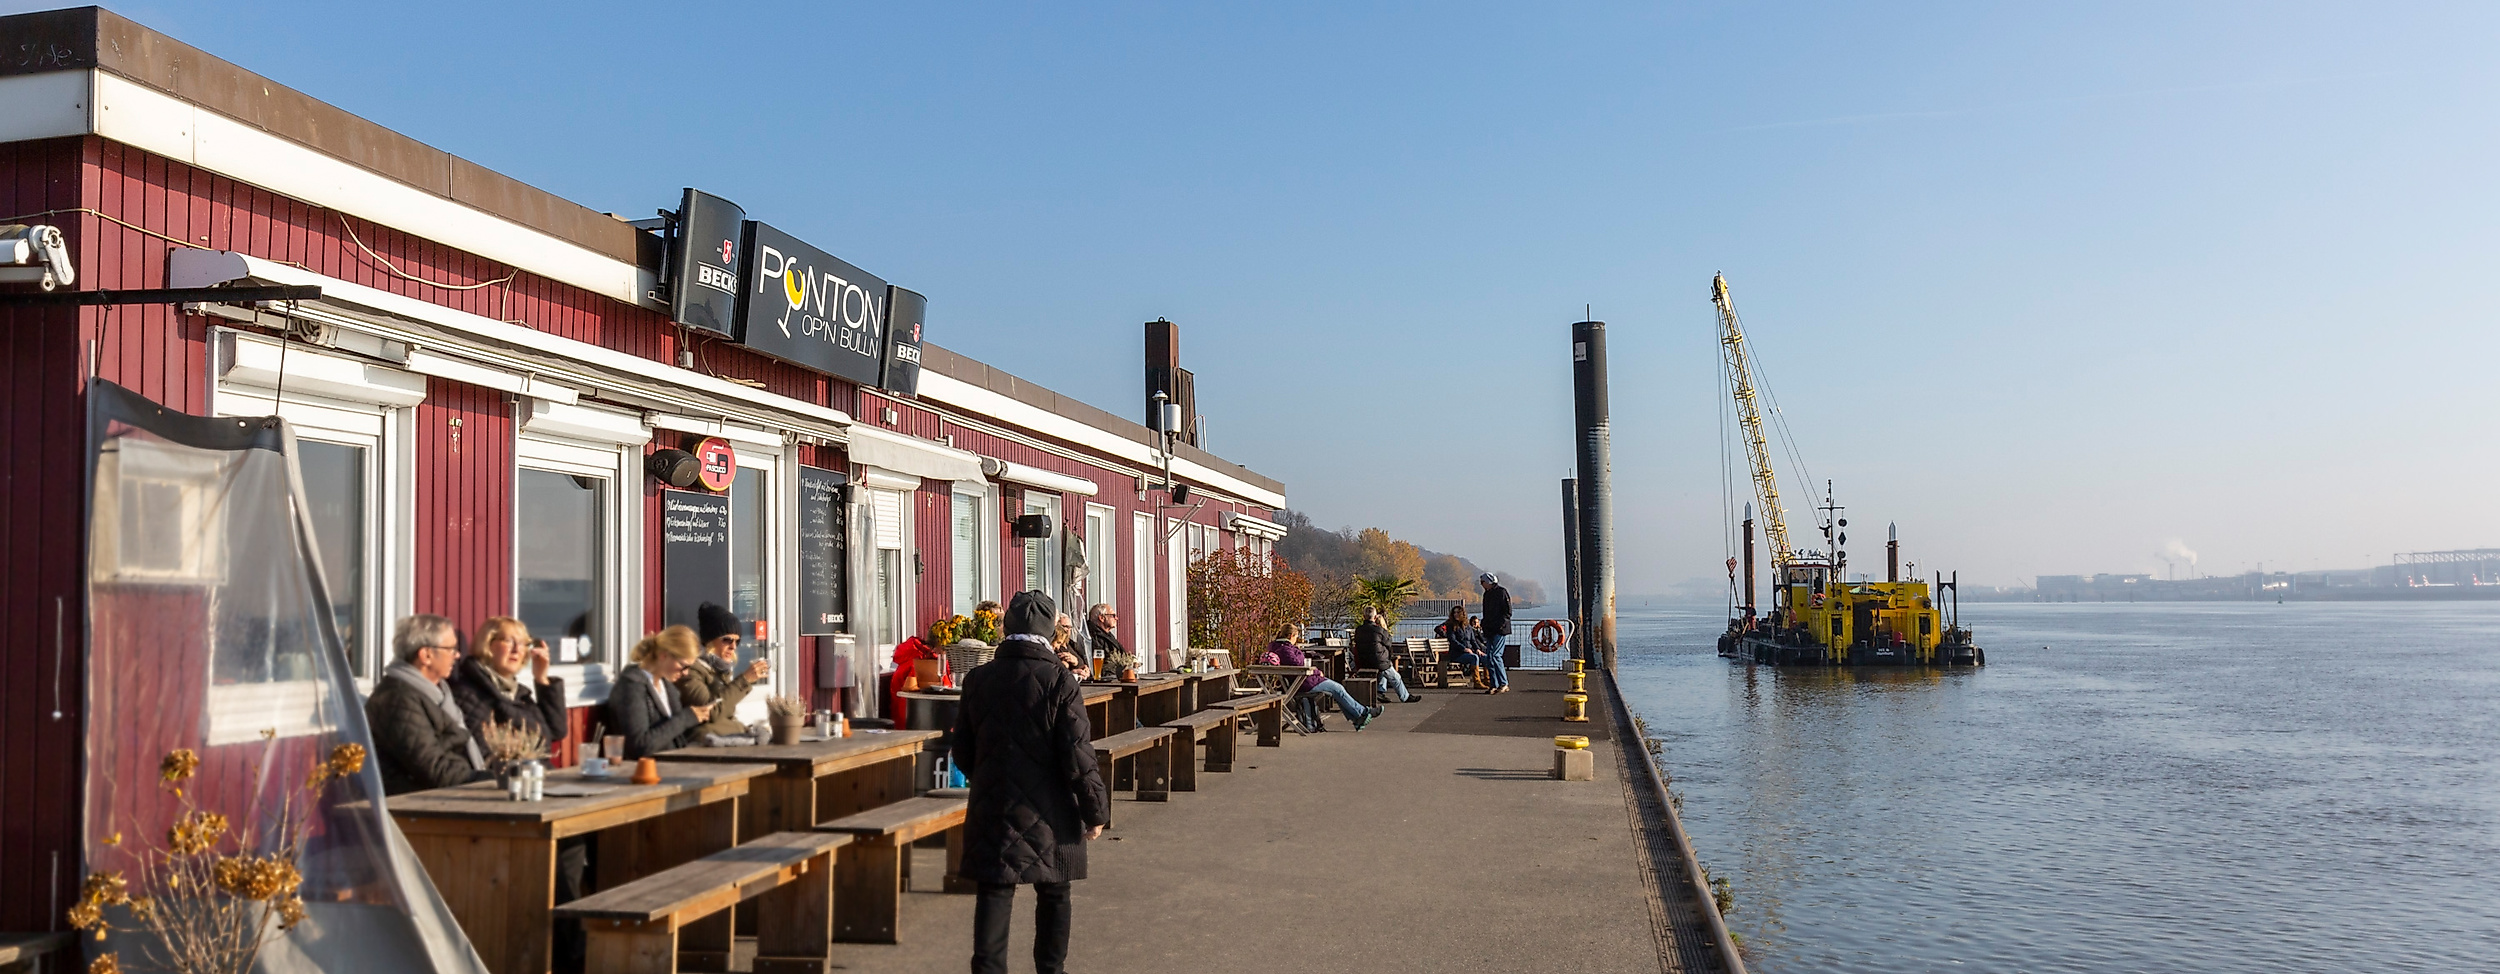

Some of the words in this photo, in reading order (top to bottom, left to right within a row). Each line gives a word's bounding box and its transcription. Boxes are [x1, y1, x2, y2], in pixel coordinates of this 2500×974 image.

[759, 244, 882, 338] PONTON
[802, 314, 837, 344] OP'N
[840, 327, 879, 359] BULLN
